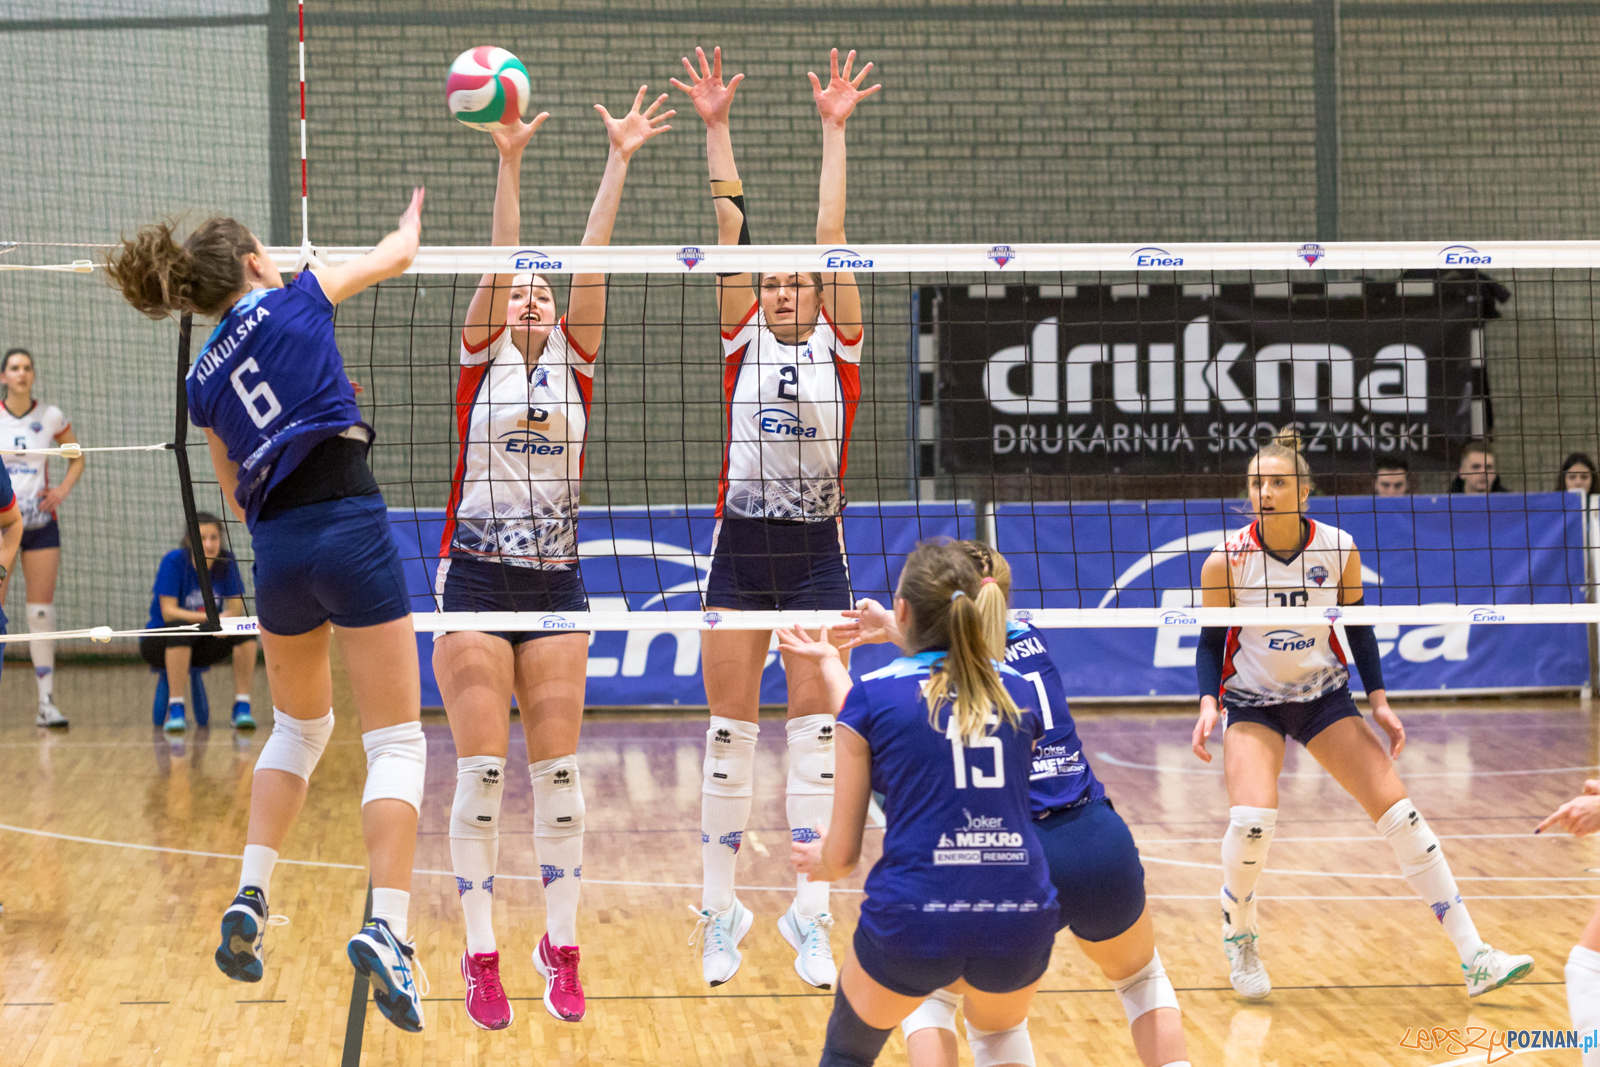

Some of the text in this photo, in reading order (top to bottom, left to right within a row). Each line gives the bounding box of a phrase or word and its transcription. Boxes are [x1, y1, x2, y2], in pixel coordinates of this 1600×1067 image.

[515, 258, 562, 269] Enea
[826, 257, 873, 268] Enea
[1137, 255, 1184, 266] Enea
[1445, 253, 1491, 264] Enea
[982, 315, 1428, 414] drukma
[778, 366, 798, 400] 2
[230, 356, 282, 429] 6
[761, 417, 817, 438] Enea
[993, 423, 1195, 454] DRUKARNIA
[505, 438, 564, 455] Enea
[542, 620, 576, 629] Enea
[1164, 616, 1197, 625] Enea
[1473, 613, 1505, 621] Enea
[1003, 636, 1047, 664] WSKA
[1268, 637, 1315, 651] Enea
[945, 714, 1005, 789] 15
[962, 807, 1004, 832] Joker
[956, 832, 1024, 847] MEKRO
[937, 852, 1025, 861] ENERGO REMONT
